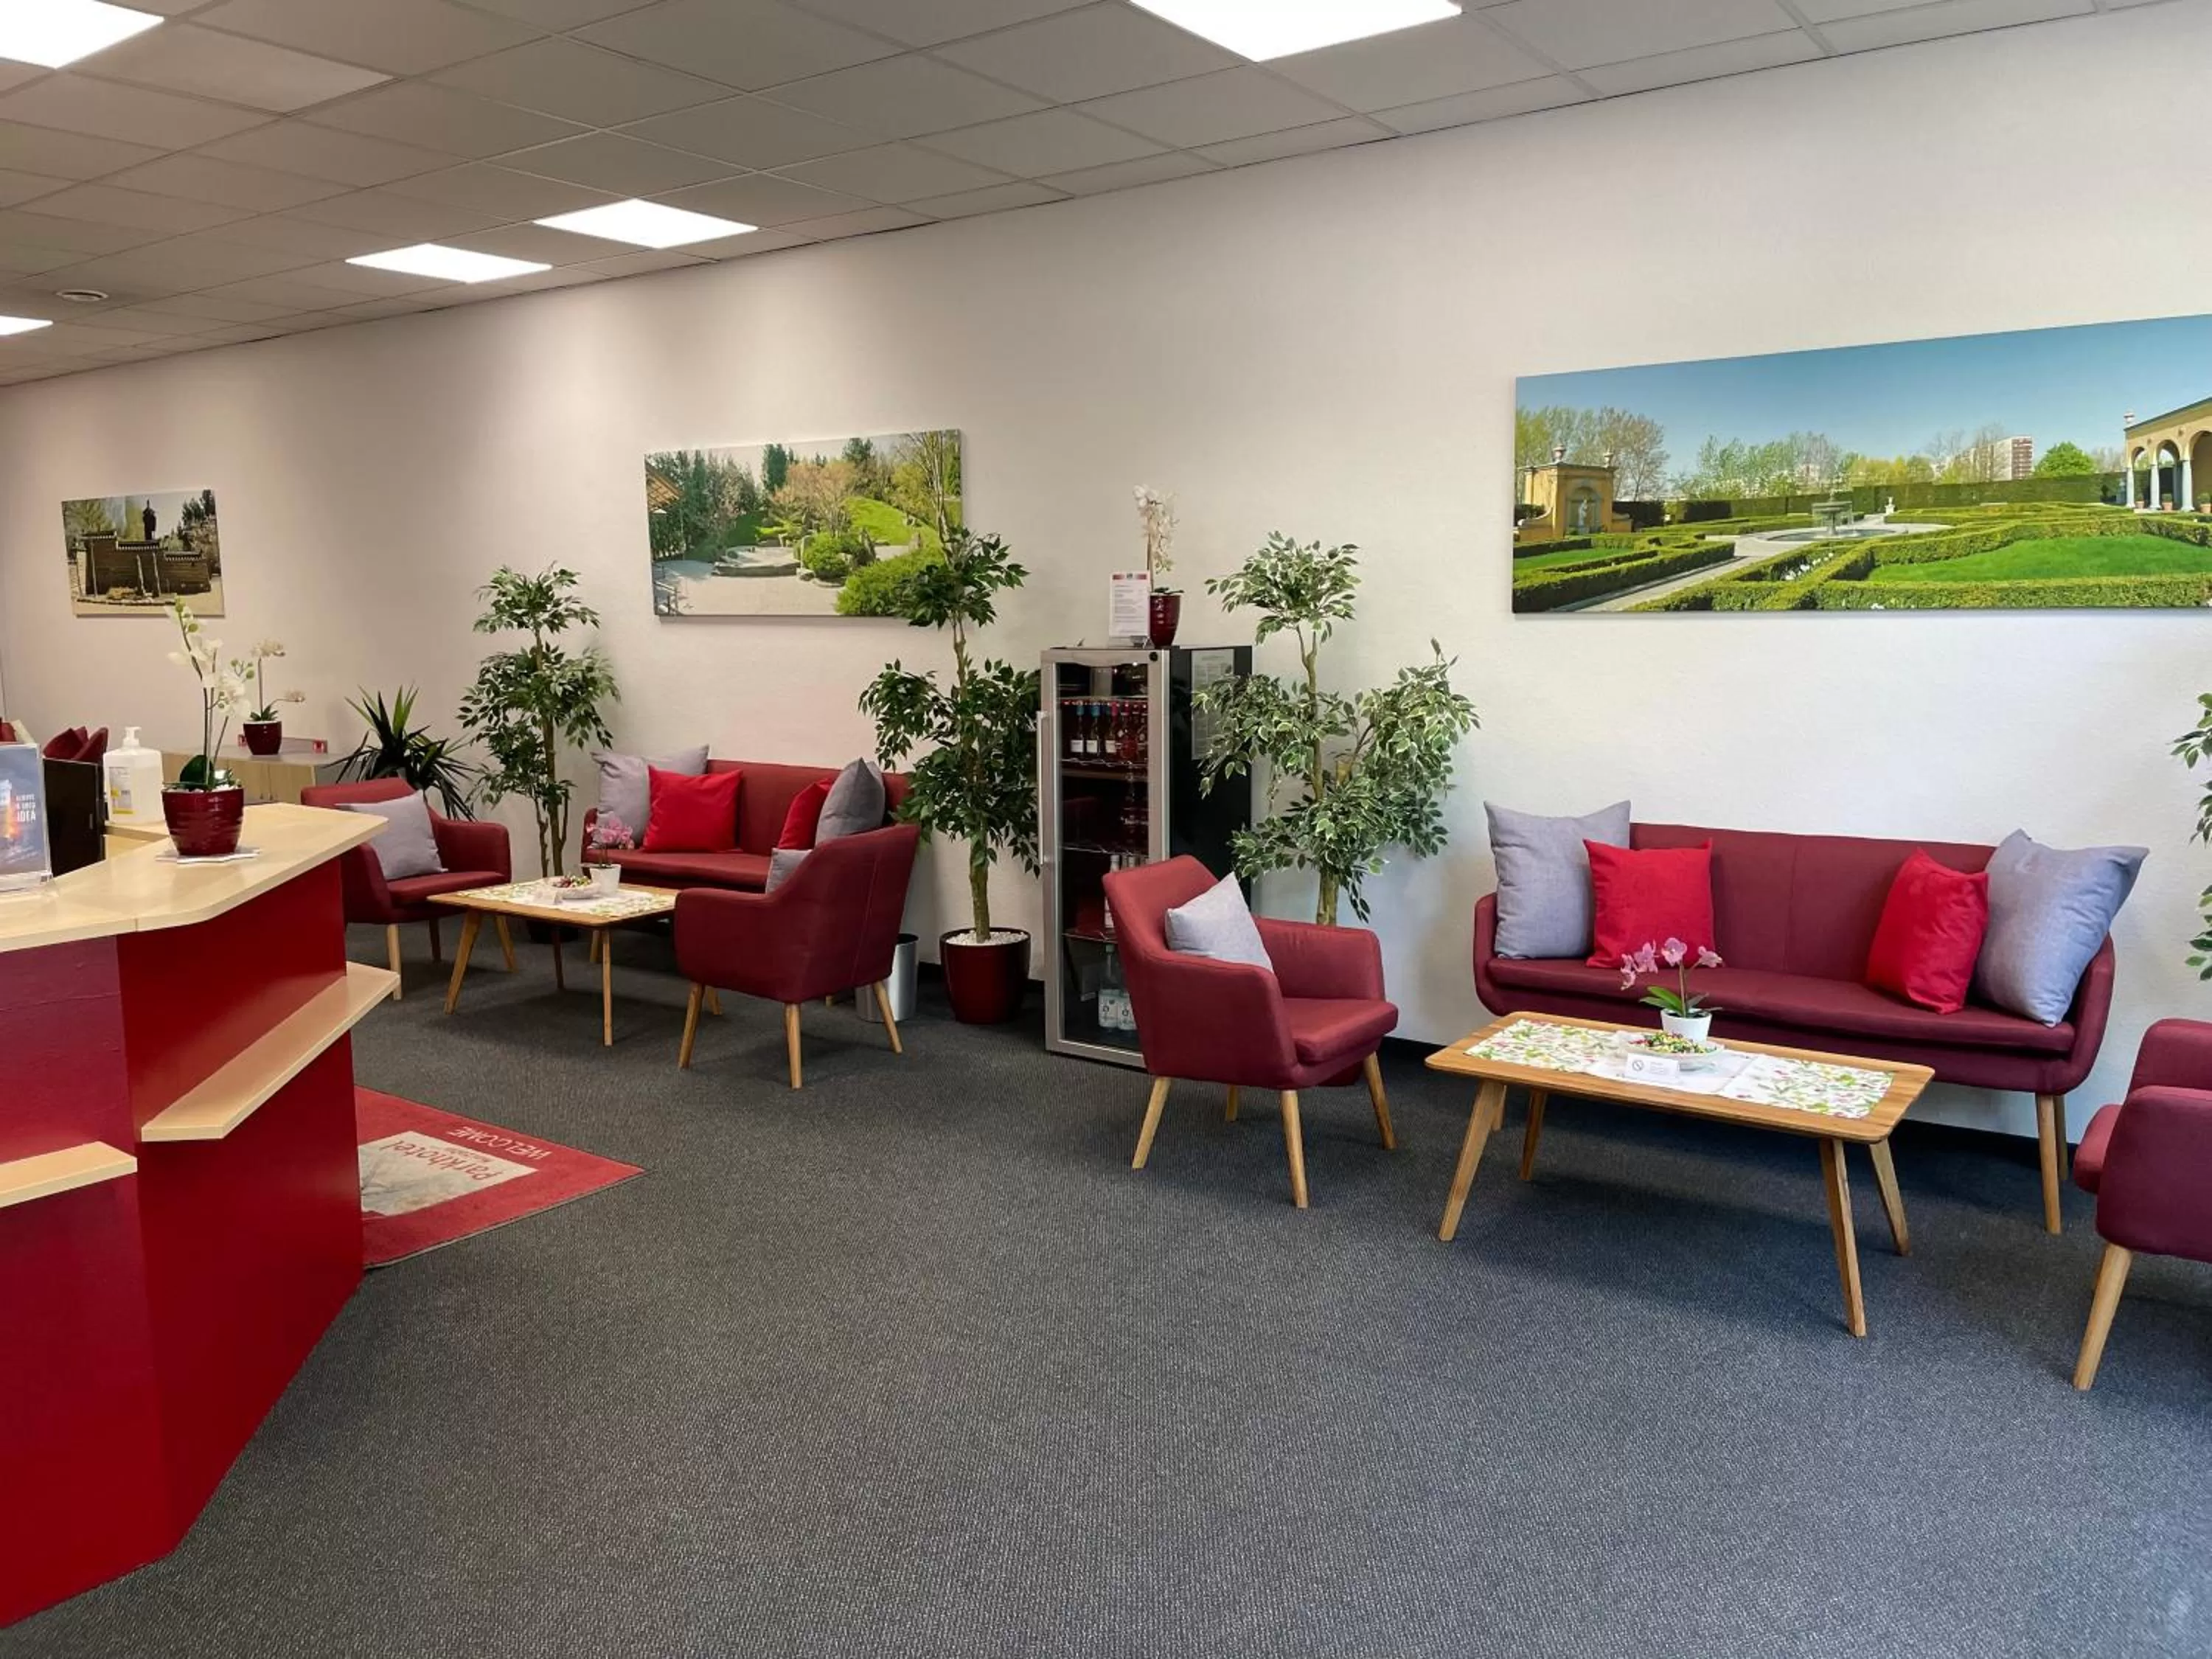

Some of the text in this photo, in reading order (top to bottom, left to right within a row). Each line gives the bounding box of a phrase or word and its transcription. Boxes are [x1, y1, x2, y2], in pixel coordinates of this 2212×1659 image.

[17, 810, 36, 823] IDEA
[379, 1140, 503, 1180] Parkhotel
[446, 1126, 552, 1160] WELCOME
